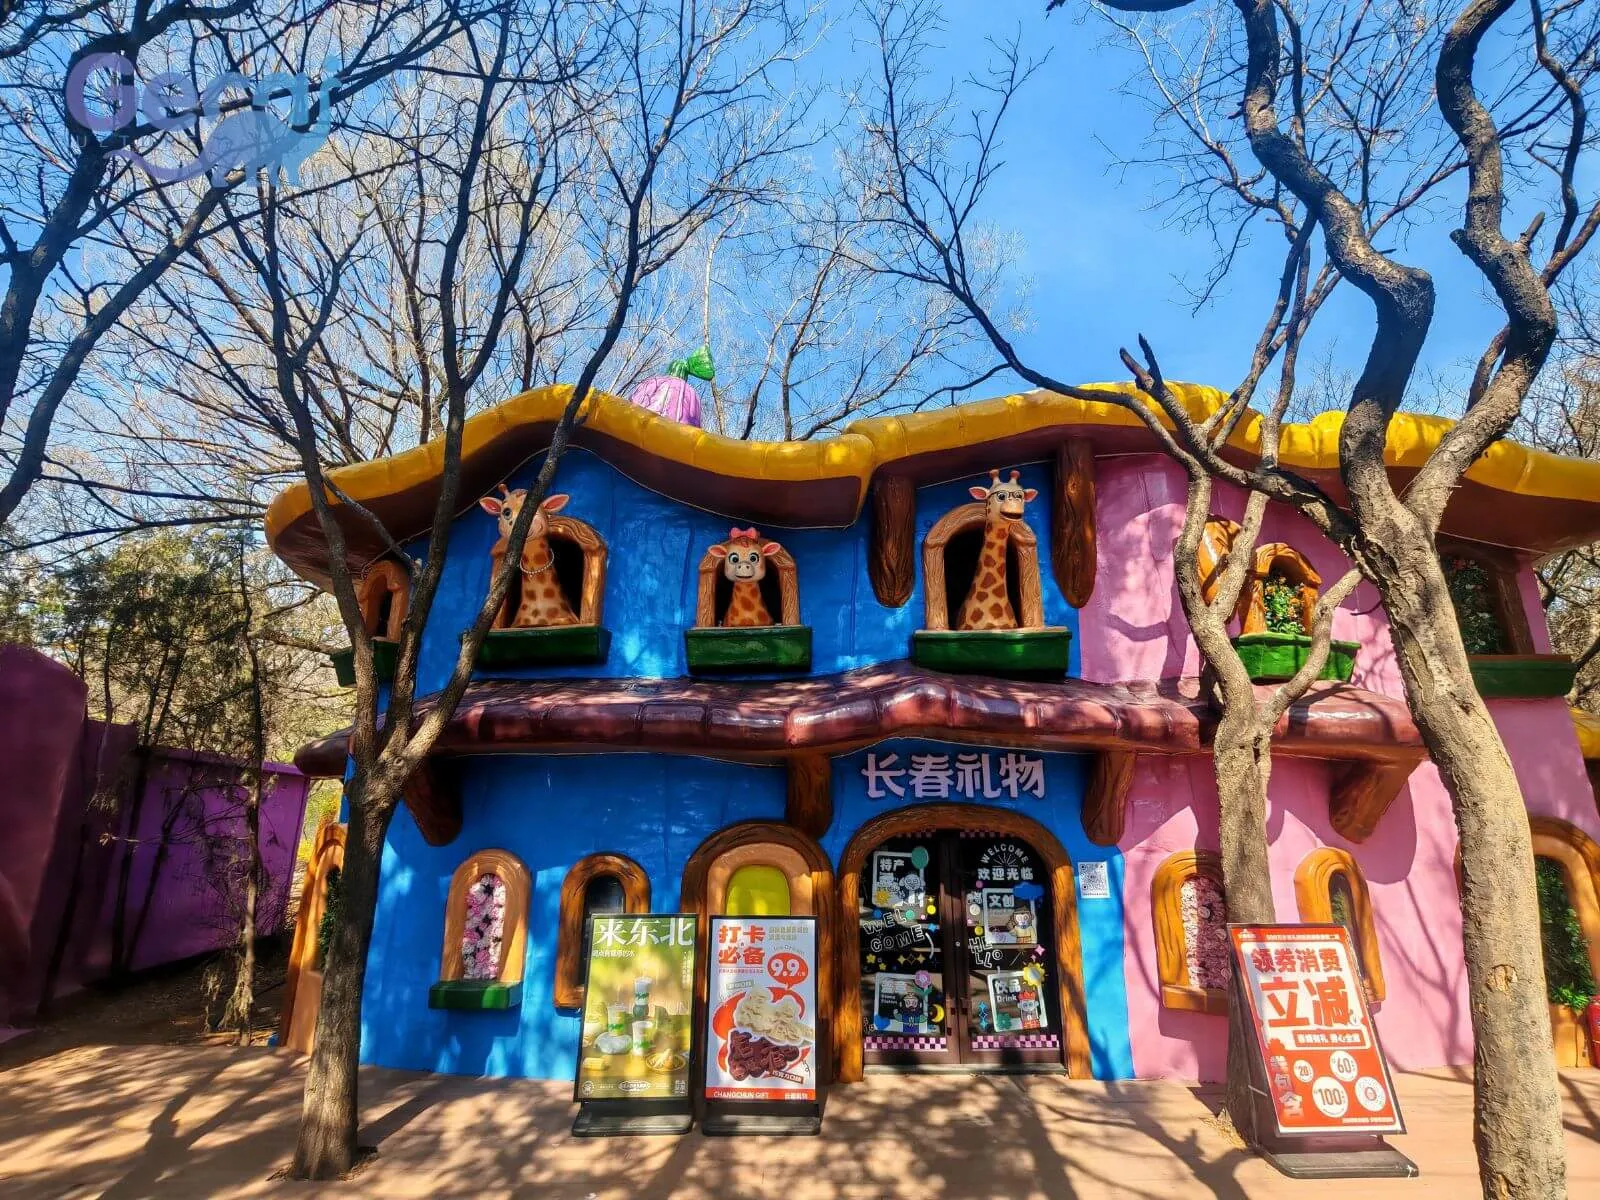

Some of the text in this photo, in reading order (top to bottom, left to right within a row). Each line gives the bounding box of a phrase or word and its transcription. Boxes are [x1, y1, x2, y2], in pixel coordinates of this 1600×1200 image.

[861, 753, 1046, 799] 长春礼物
[980, 843, 1030, 864] WELCOME
[880, 858, 905, 872] 特产
[977, 867, 1034, 881] 欢迎光临
[988, 894, 1015, 908] 文创
[593, 917, 695, 947] 来东北
[718, 925, 766, 944] 打卡
[870, 924, 925, 952] COME
[718, 945, 766, 965] 必备
[1250, 947, 1343, 973] 领券消费
[770, 958, 800, 977] 9.9
[994, 978, 1021, 995] 饮品
[996, 994, 1017, 1003] Drink
[1260, 976, 1350, 1028] 立减
[1337, 1057, 1352, 1074] 60
[713, 1091, 754, 1099] CHANGCHUN
[1318, 1088, 1343, 1106] 100
